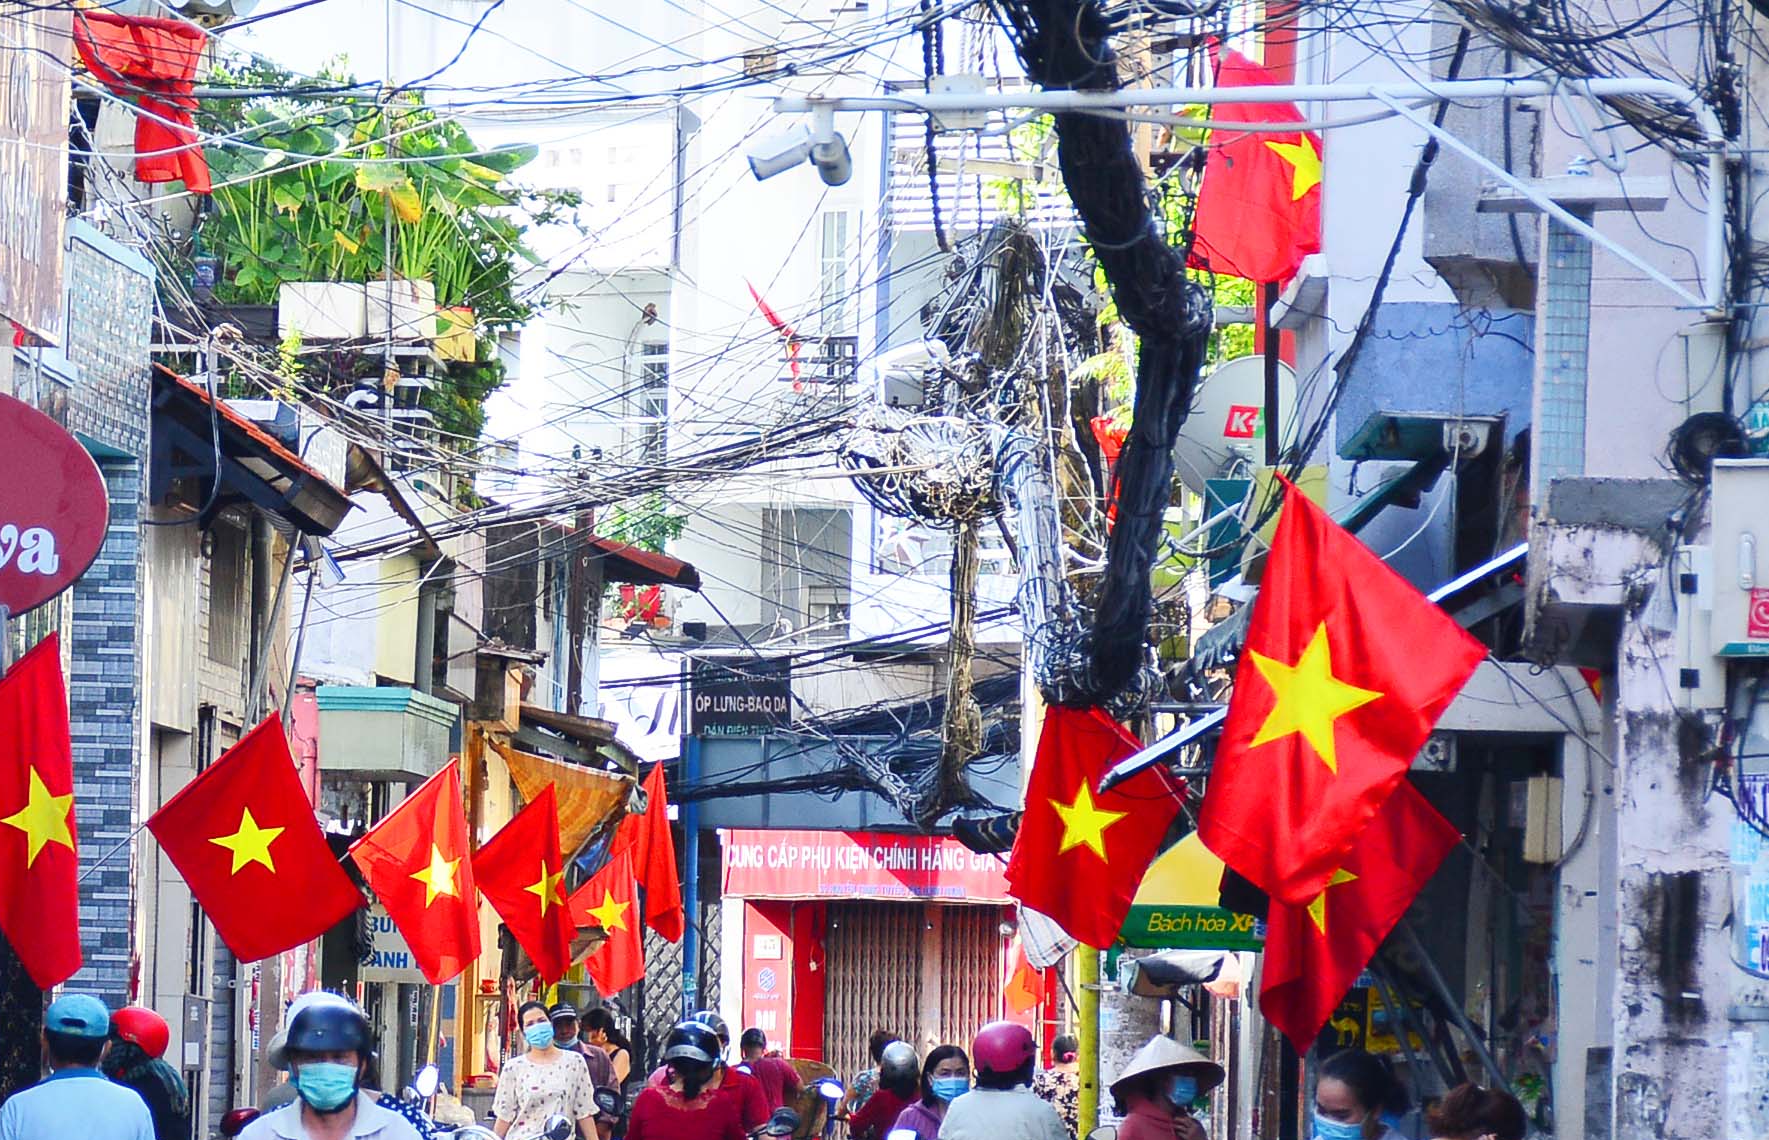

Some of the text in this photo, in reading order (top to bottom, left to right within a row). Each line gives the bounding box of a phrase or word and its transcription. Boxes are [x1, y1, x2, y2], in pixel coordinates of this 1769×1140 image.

[774, 697, 787, 712] DA
[727, 844, 763, 868] CUNG
[767, 837, 798, 868] CẤP
[801, 845, 831, 875] PHỤ
[835, 843, 869, 875] KIỆN
[873, 842, 917, 870] CHÍNH
[1147, 912, 1192, 932] Bách
[1195, 911, 1226, 932] hóa
